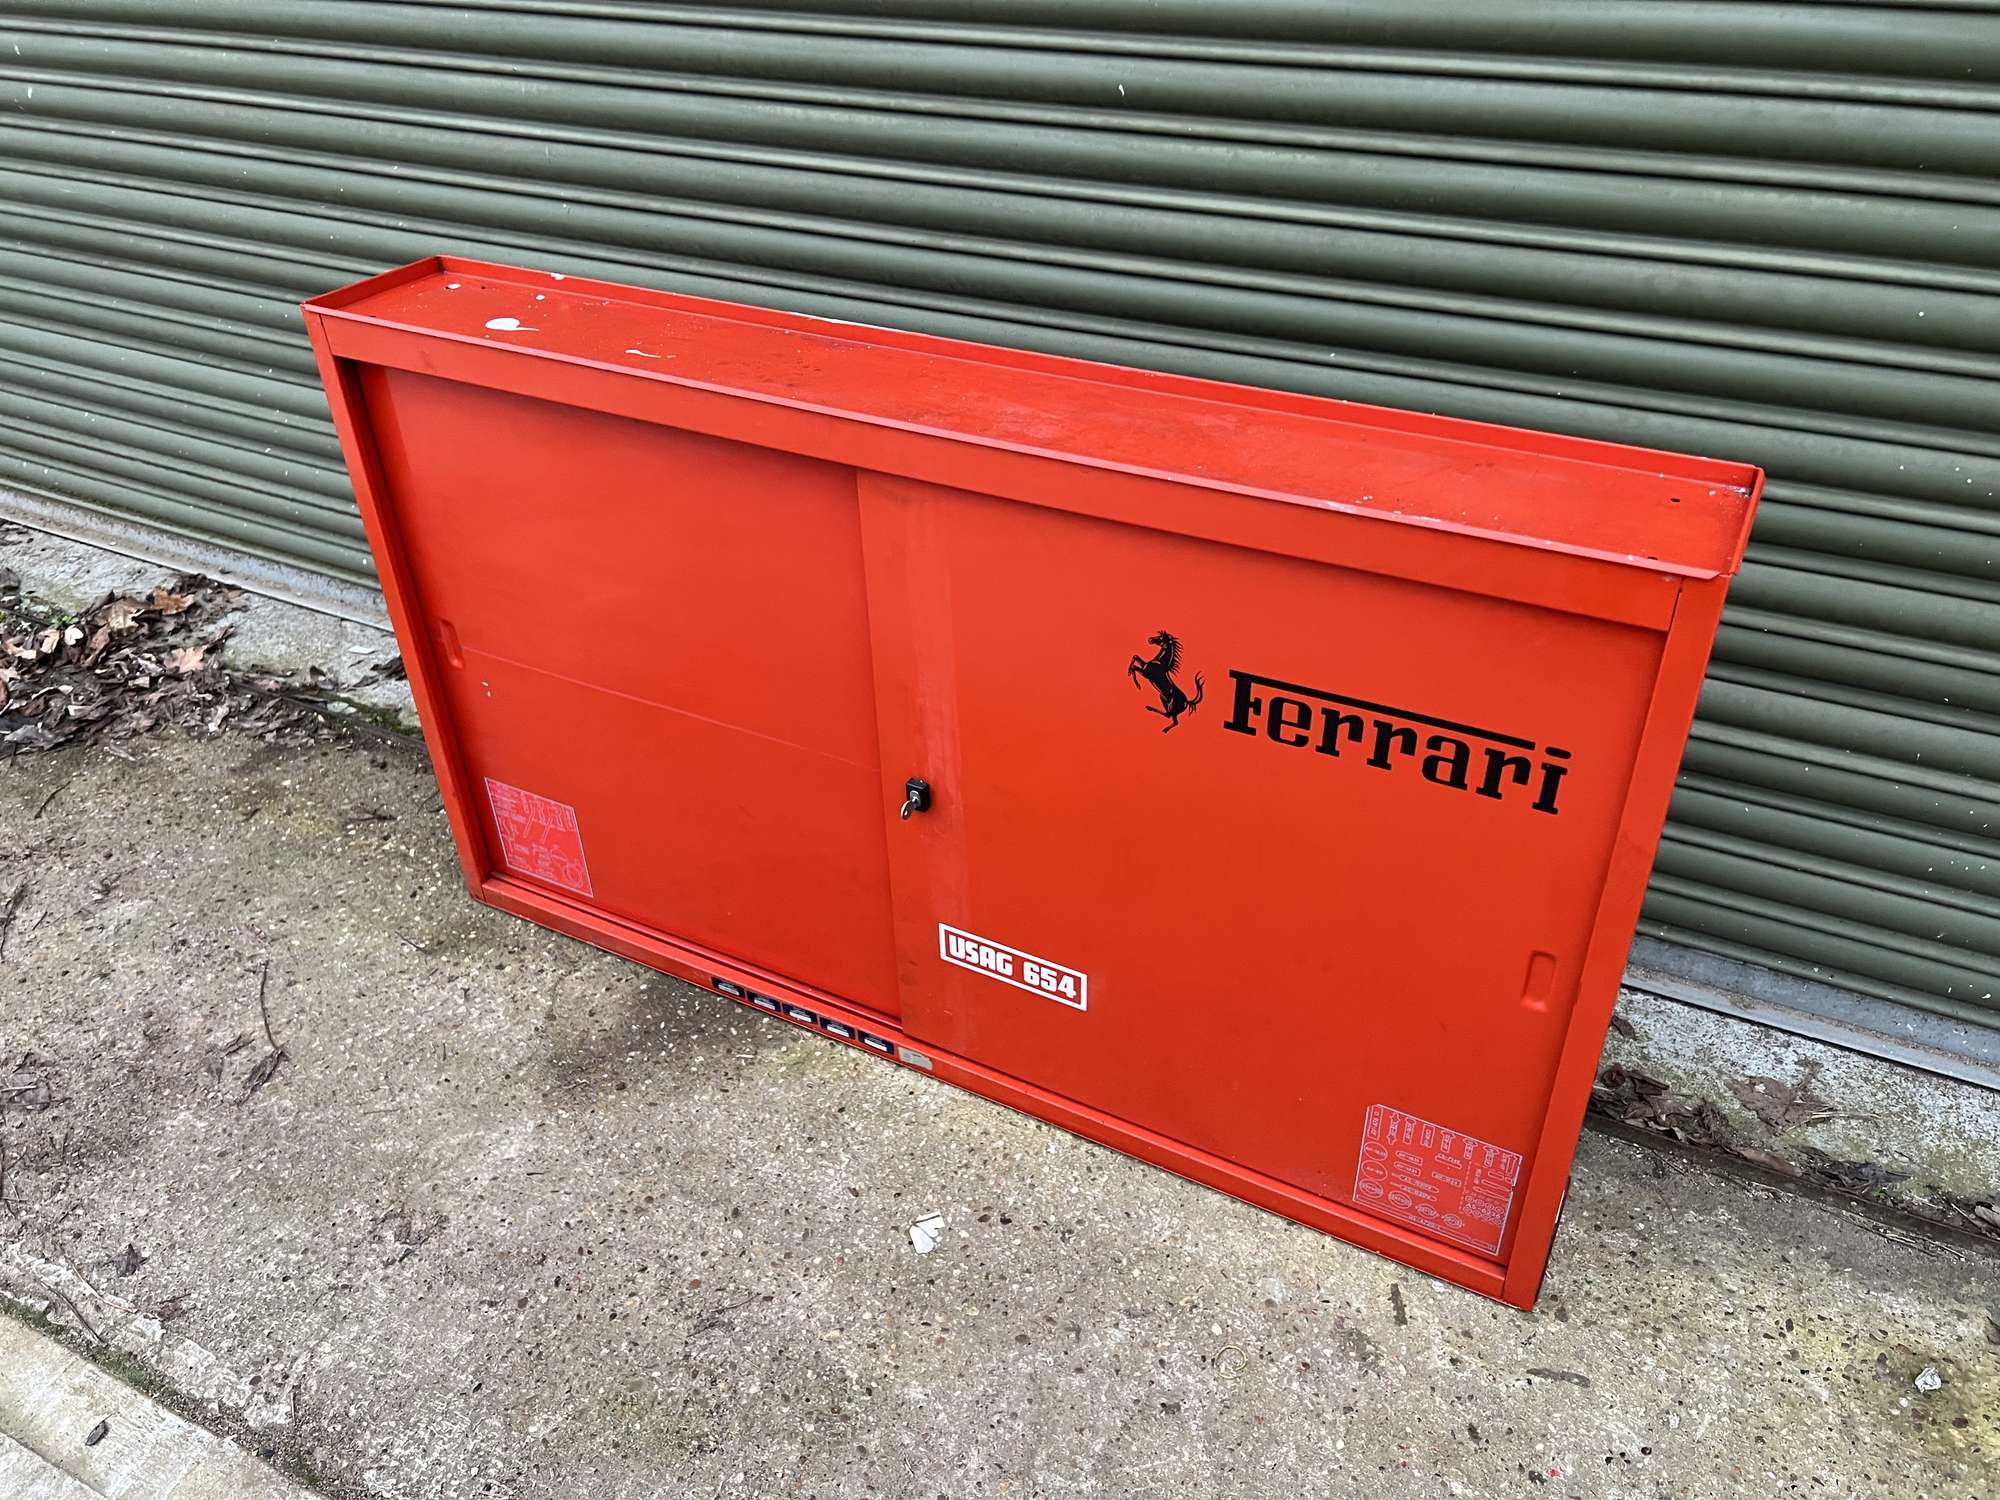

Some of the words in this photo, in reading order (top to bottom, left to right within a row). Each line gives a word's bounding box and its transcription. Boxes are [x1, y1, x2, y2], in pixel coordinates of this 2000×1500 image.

[1223, 669, 1572, 815] Ferrari
[948, 934, 1013, 976] USAG
[1023, 961, 1076, 999] 654
